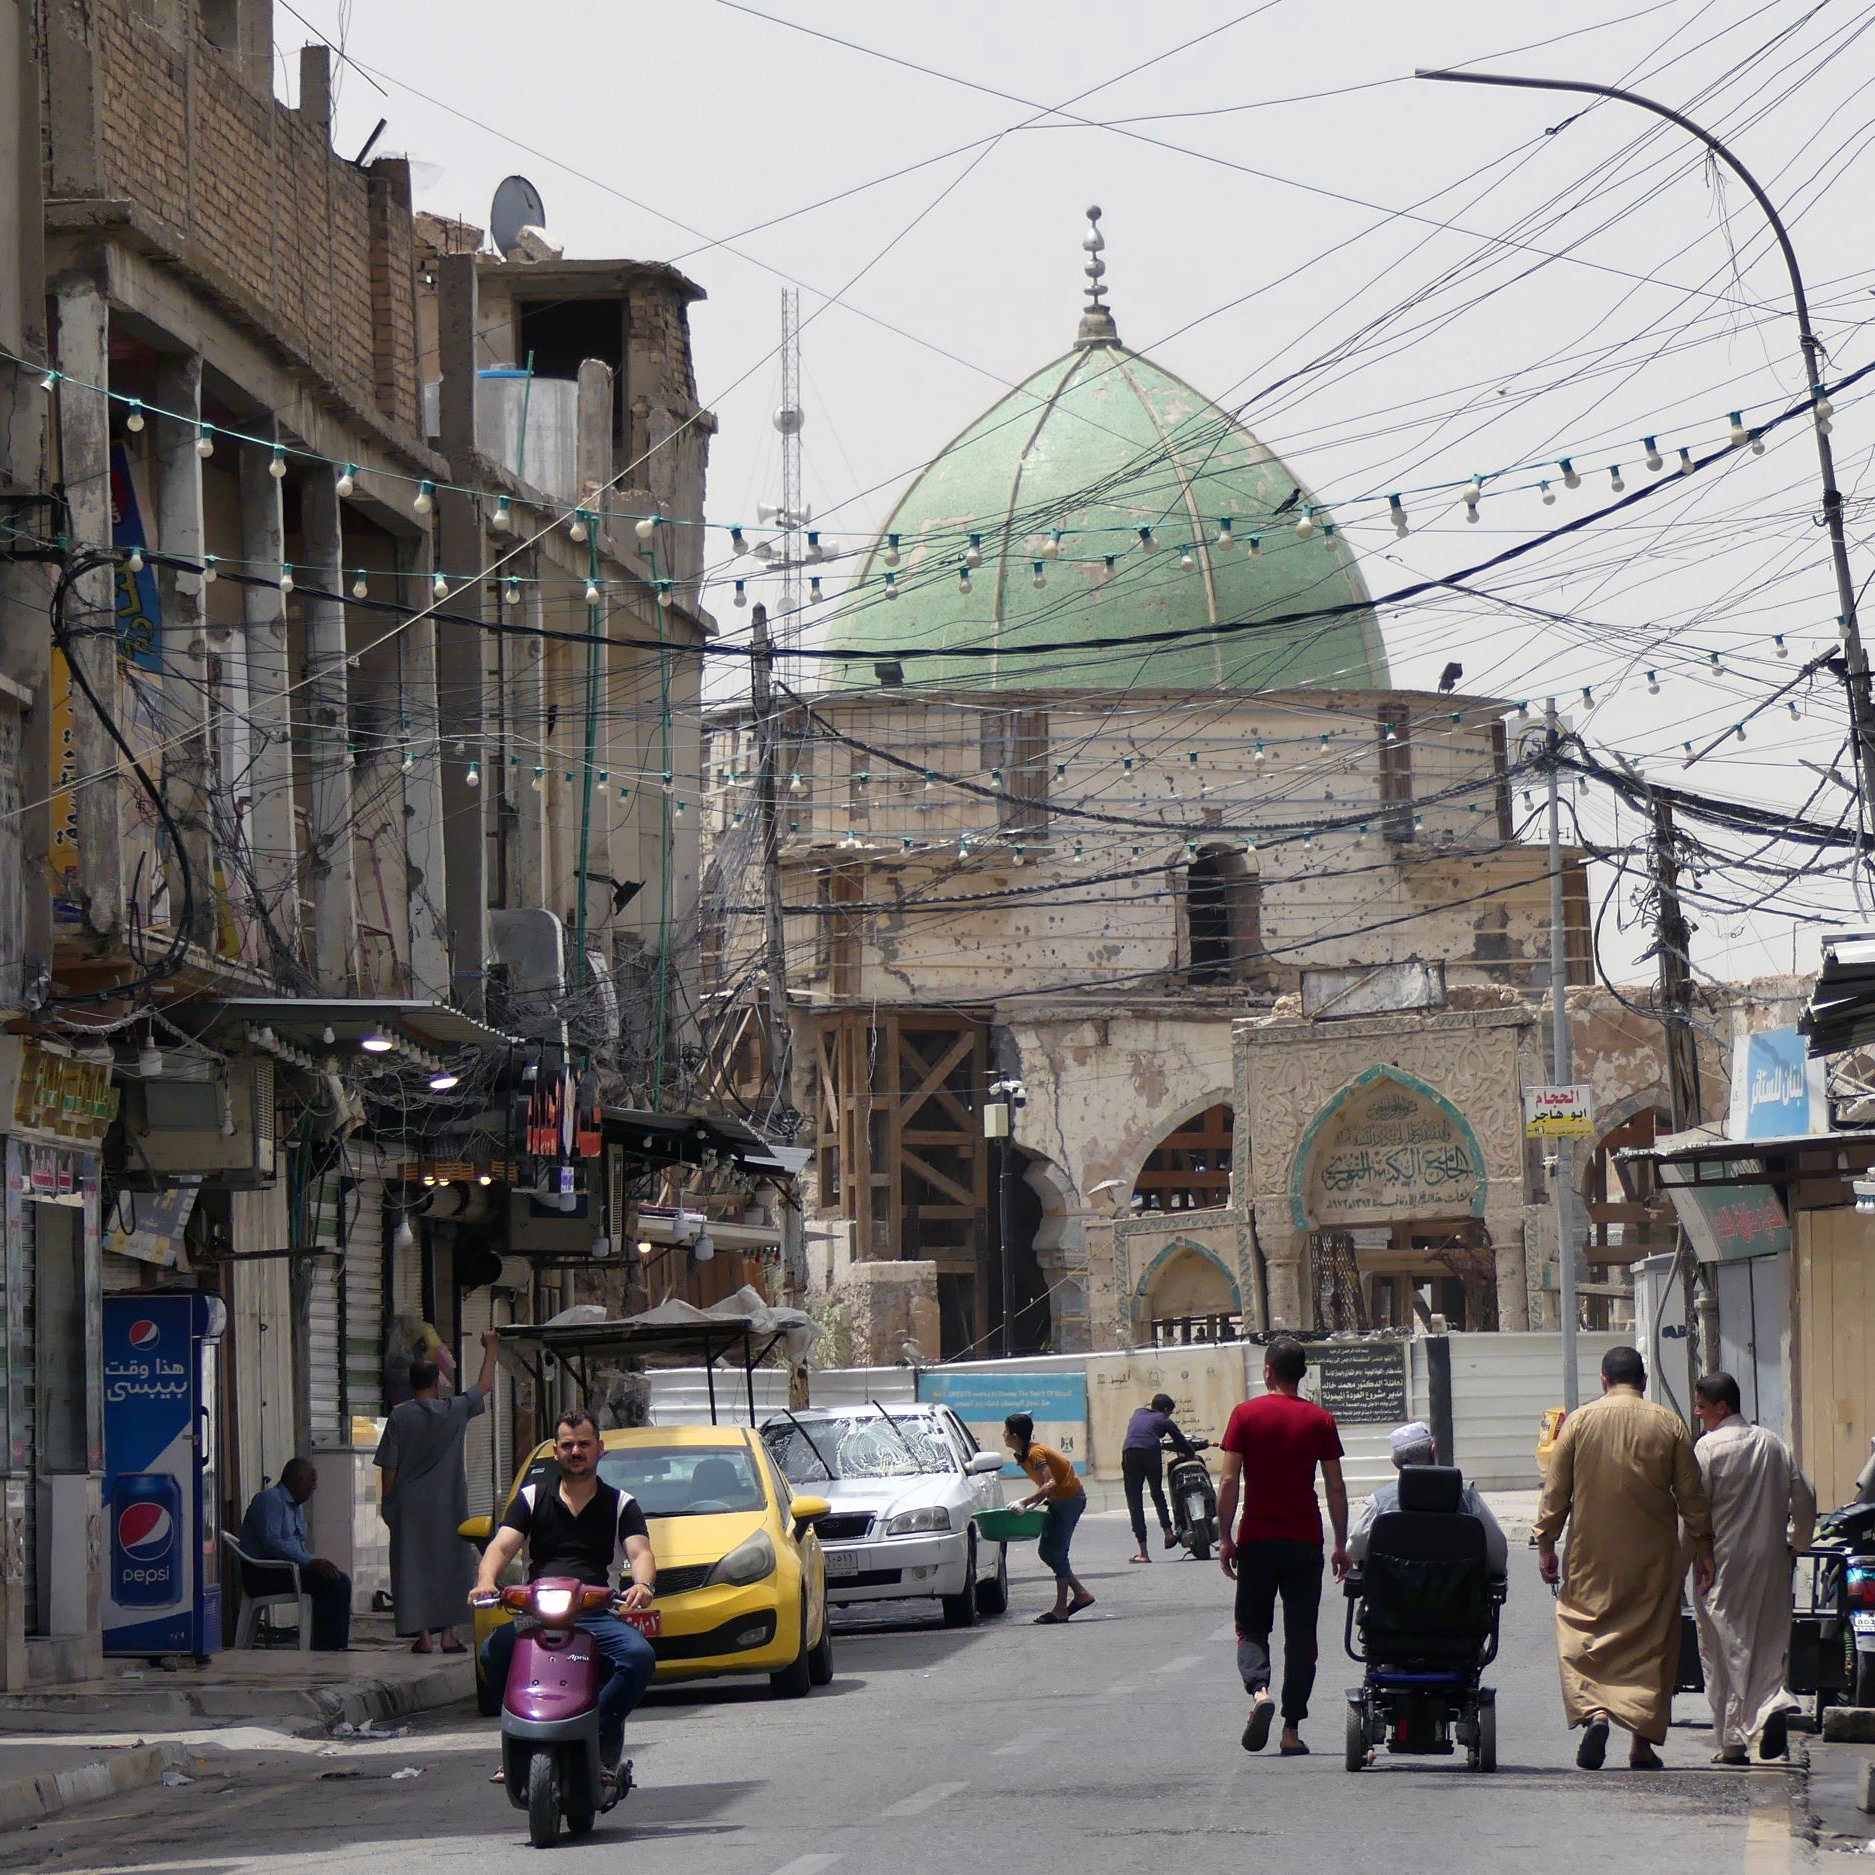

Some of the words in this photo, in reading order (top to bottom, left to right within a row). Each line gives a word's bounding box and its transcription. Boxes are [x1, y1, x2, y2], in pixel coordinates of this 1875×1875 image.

[1782, 1062, 1804, 1108] لبنان
[1535, 1089, 1580, 1109] الحجام
[1531, 1109, 1564, 1123] هاجر
[1570, 1108, 1587, 1122] ابو
[104, 1360, 150, 1379] وقت
[155, 1358, 185, 1375] هذا
[1338, 1381, 1356, 1389] محمد
[1365, 1389, 1386, 1401] مشروع
[122, 1565, 170, 1585] pepsi
